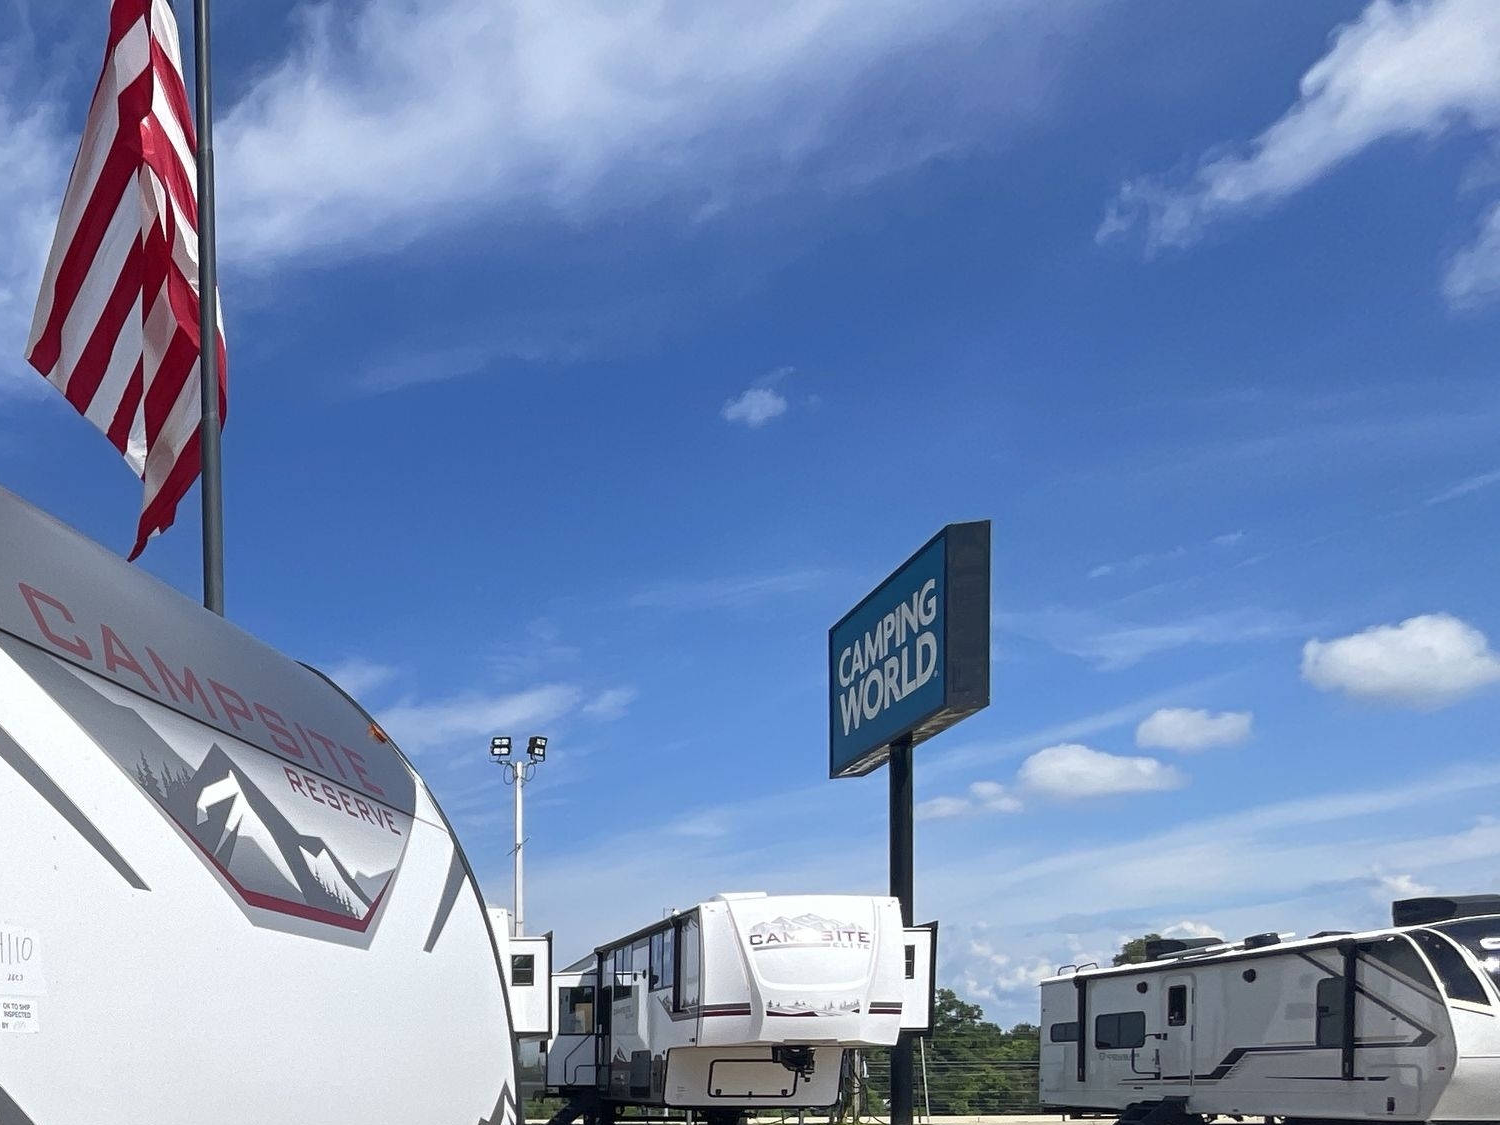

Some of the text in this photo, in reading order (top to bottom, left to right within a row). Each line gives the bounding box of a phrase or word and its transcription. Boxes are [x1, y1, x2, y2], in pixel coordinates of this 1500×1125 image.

[838, 578, 937, 688] CAMPING
[18, 582, 384, 795] CAMPSITE
[839, 631, 938, 737] WORLD
[283, 766, 402, 836] RESERVE
[749, 929, 871, 946] CAMSITE
[832, 941, 870, 950] ELITE
[2, 1002, 11, 1010] OK
[11, 1003, 19, 1011] TO
[3, 1010, 32, 1019] INSPECTED
